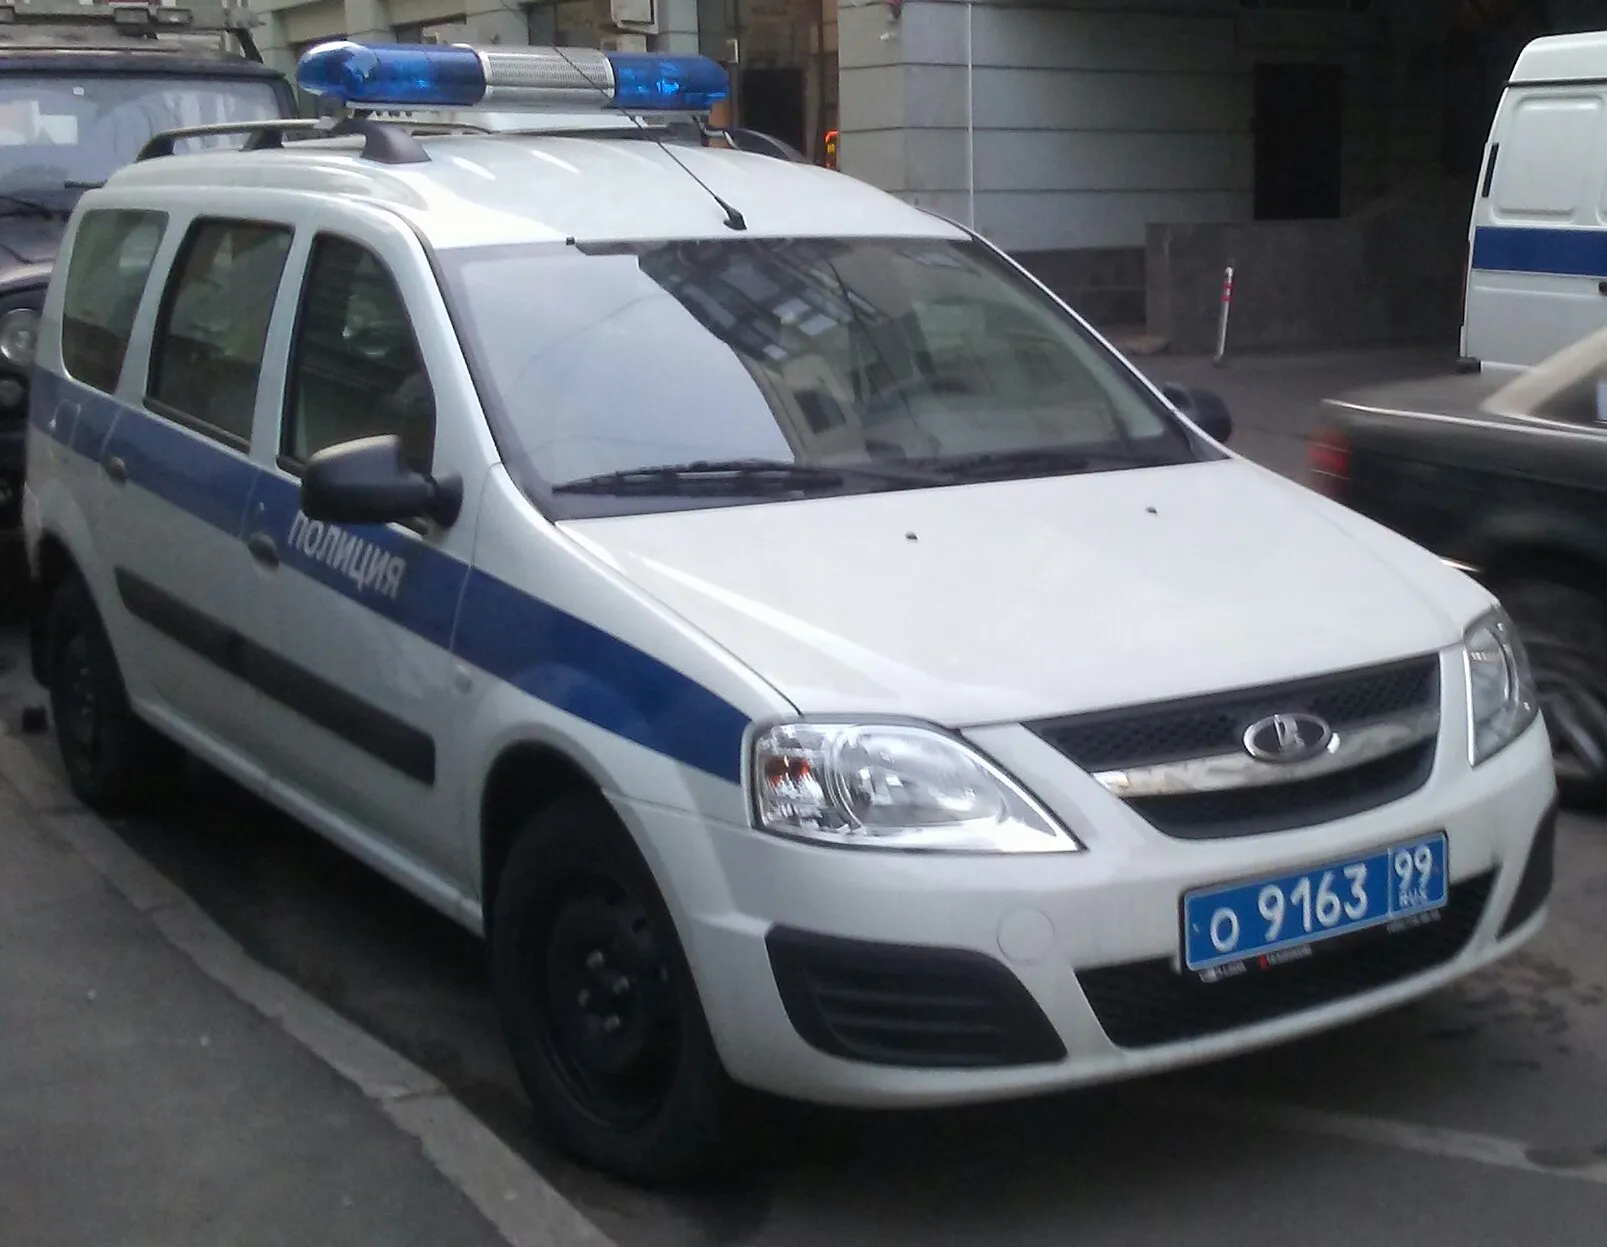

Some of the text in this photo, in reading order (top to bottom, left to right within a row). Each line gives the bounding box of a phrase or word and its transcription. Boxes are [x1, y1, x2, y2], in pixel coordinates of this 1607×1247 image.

[287, 510, 407, 598] ПОЛИЦИЯ
[1257, 863, 1368, 941] 9163
[1394, 845, 1433, 891] 99
